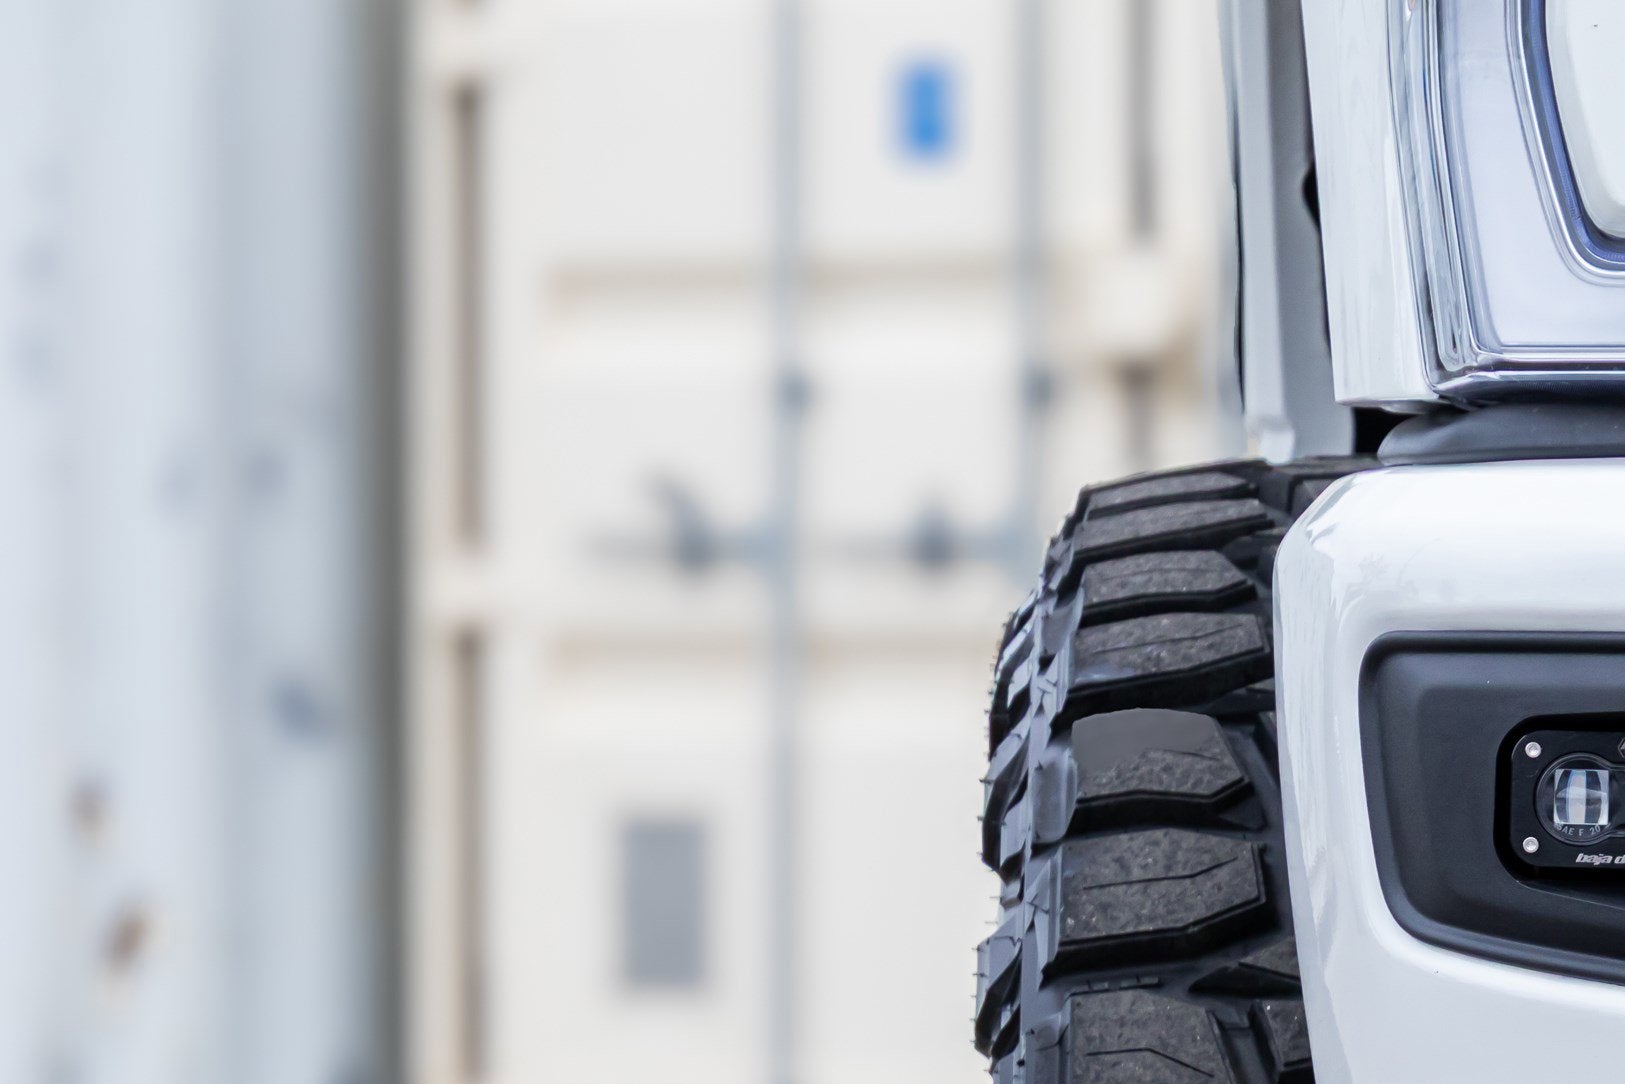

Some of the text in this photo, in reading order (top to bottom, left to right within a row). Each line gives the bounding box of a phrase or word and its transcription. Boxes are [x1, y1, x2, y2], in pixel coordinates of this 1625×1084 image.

[1555, 822, 1575, 836] SAE
[1578, 828, 1585, 836] F
[1575, 852, 1613, 866] baja
